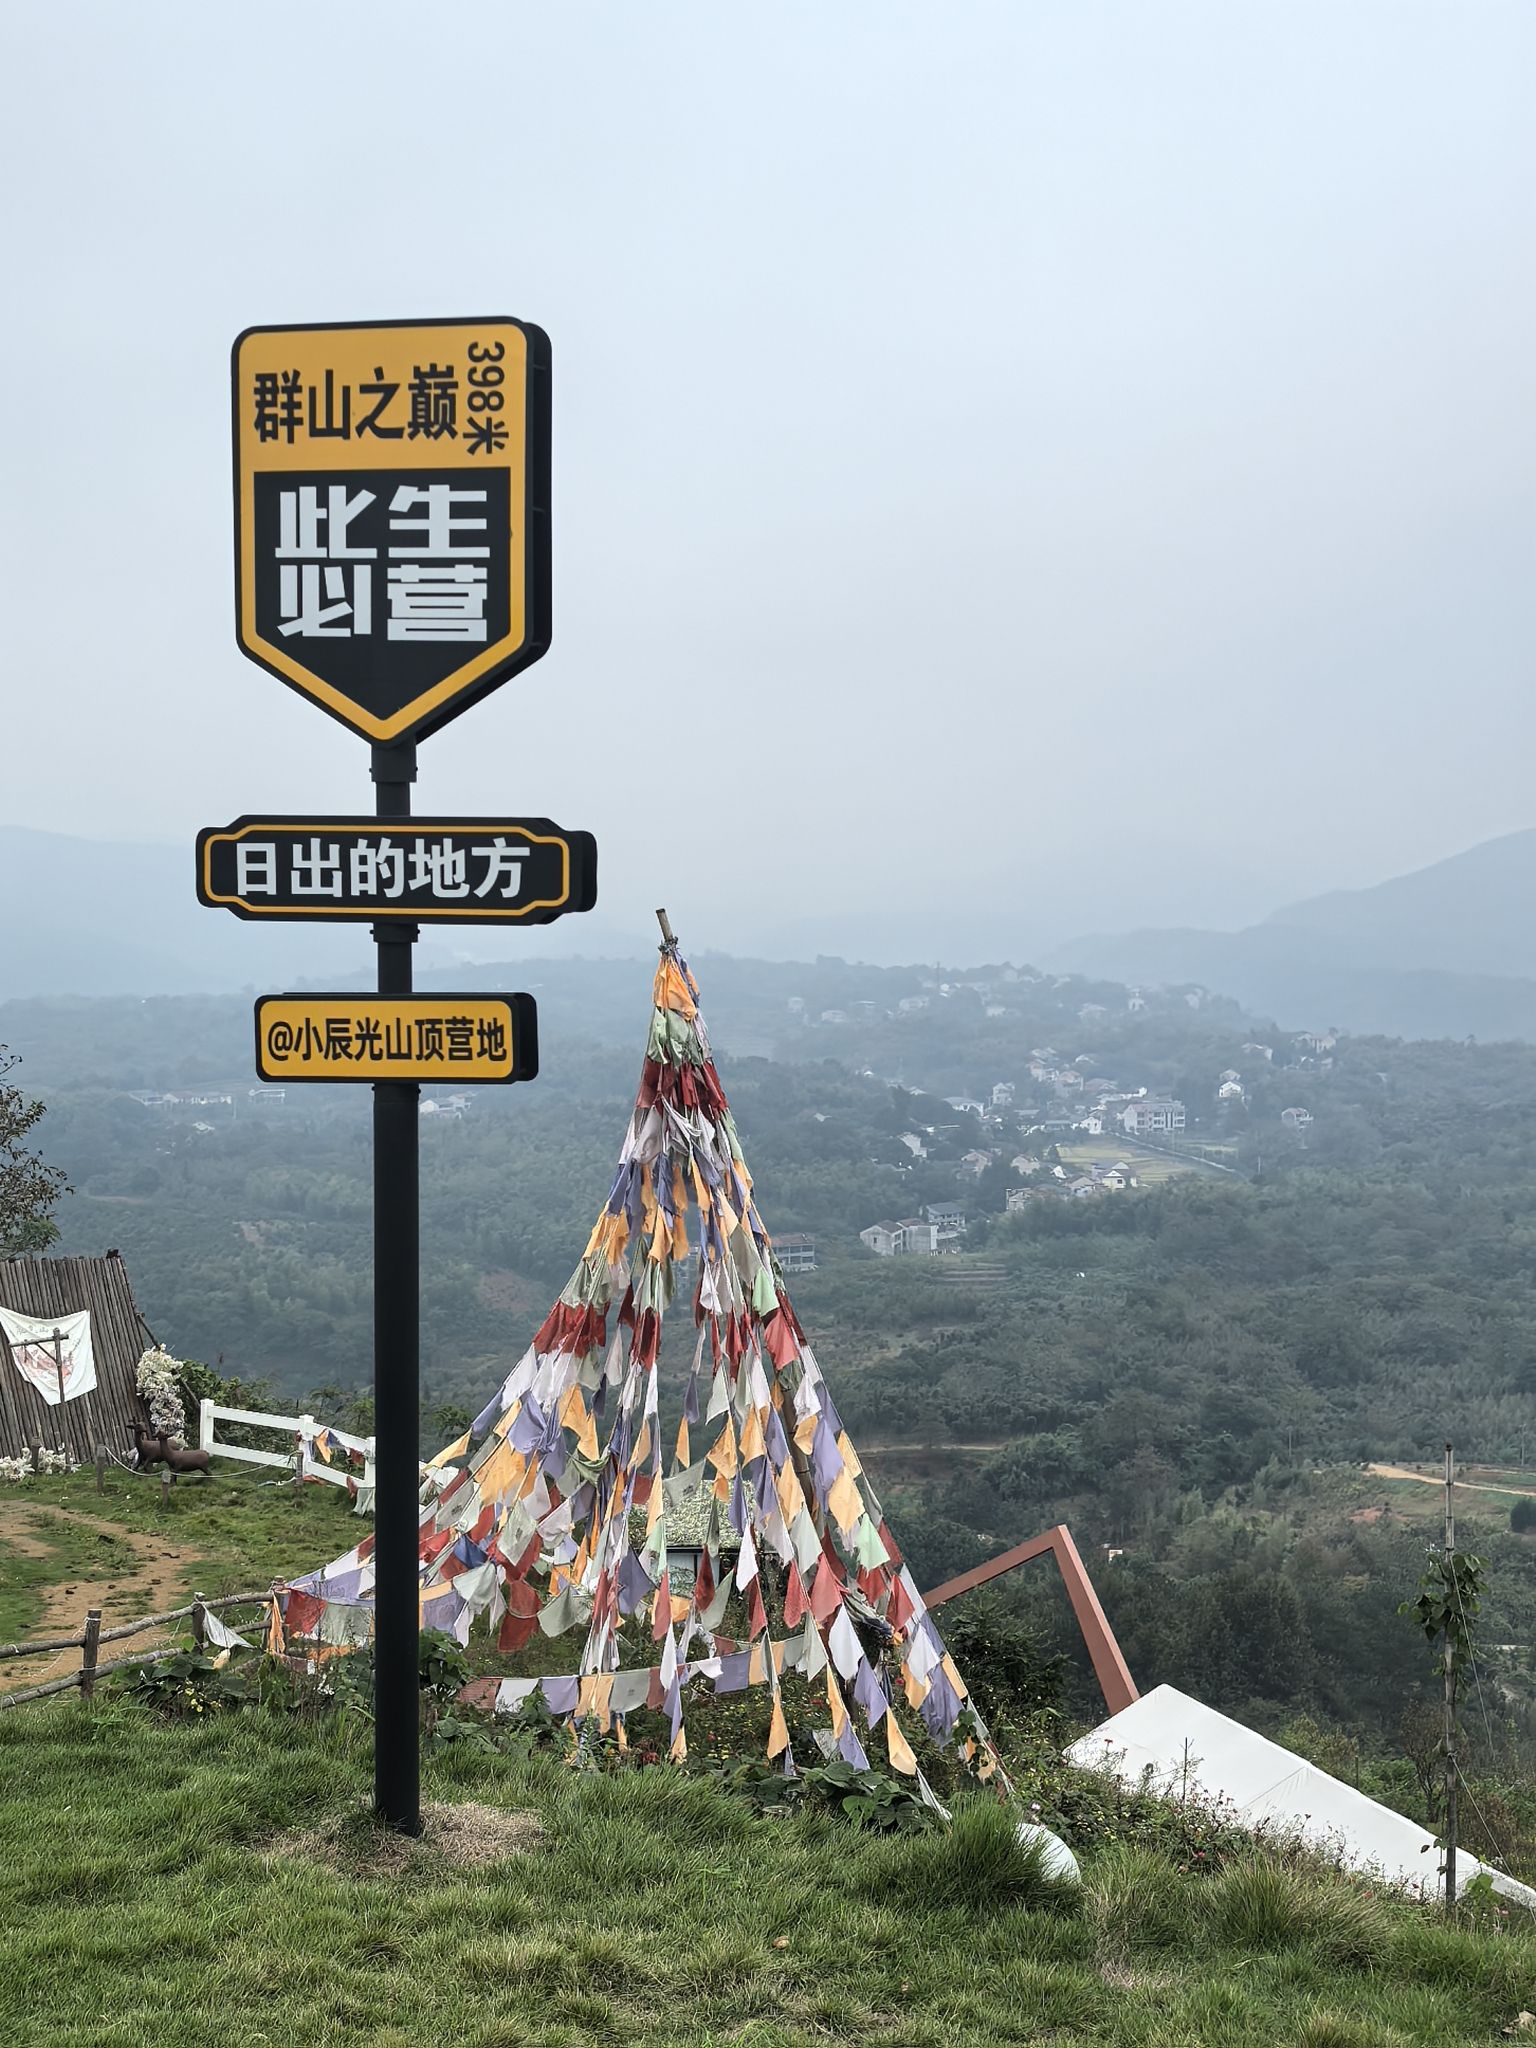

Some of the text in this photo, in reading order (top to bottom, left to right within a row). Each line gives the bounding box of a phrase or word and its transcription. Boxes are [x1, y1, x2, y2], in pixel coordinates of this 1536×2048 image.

[253, 363, 459, 444] 群山之巅
[462, 341, 509, 455] 398米
[275, 484, 490, 559] 此生
[277, 564, 487, 641] 必营
[236, 837, 531, 899] 日出的地方
[267, 1016, 507, 1062] @小辰光山顶营地
